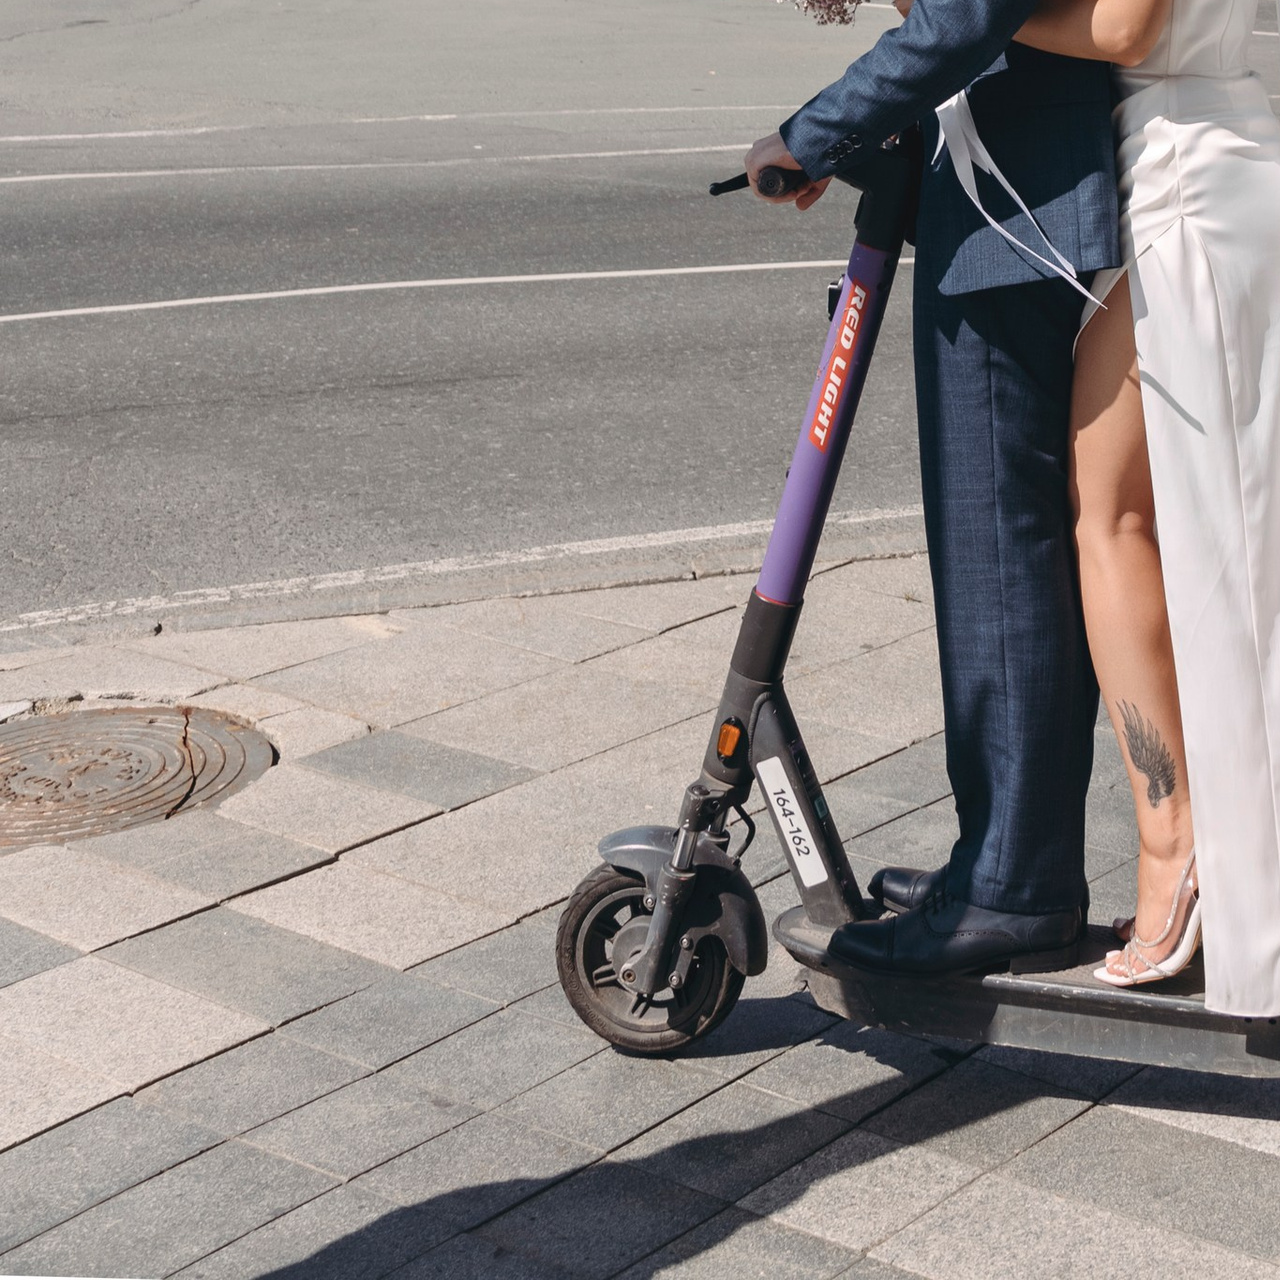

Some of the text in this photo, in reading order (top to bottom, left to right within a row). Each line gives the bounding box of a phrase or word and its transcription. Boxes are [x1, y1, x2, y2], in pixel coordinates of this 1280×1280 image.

[814, 285, 867, 446] RED LIGHT
[773, 788, 810, 856] 164-162
